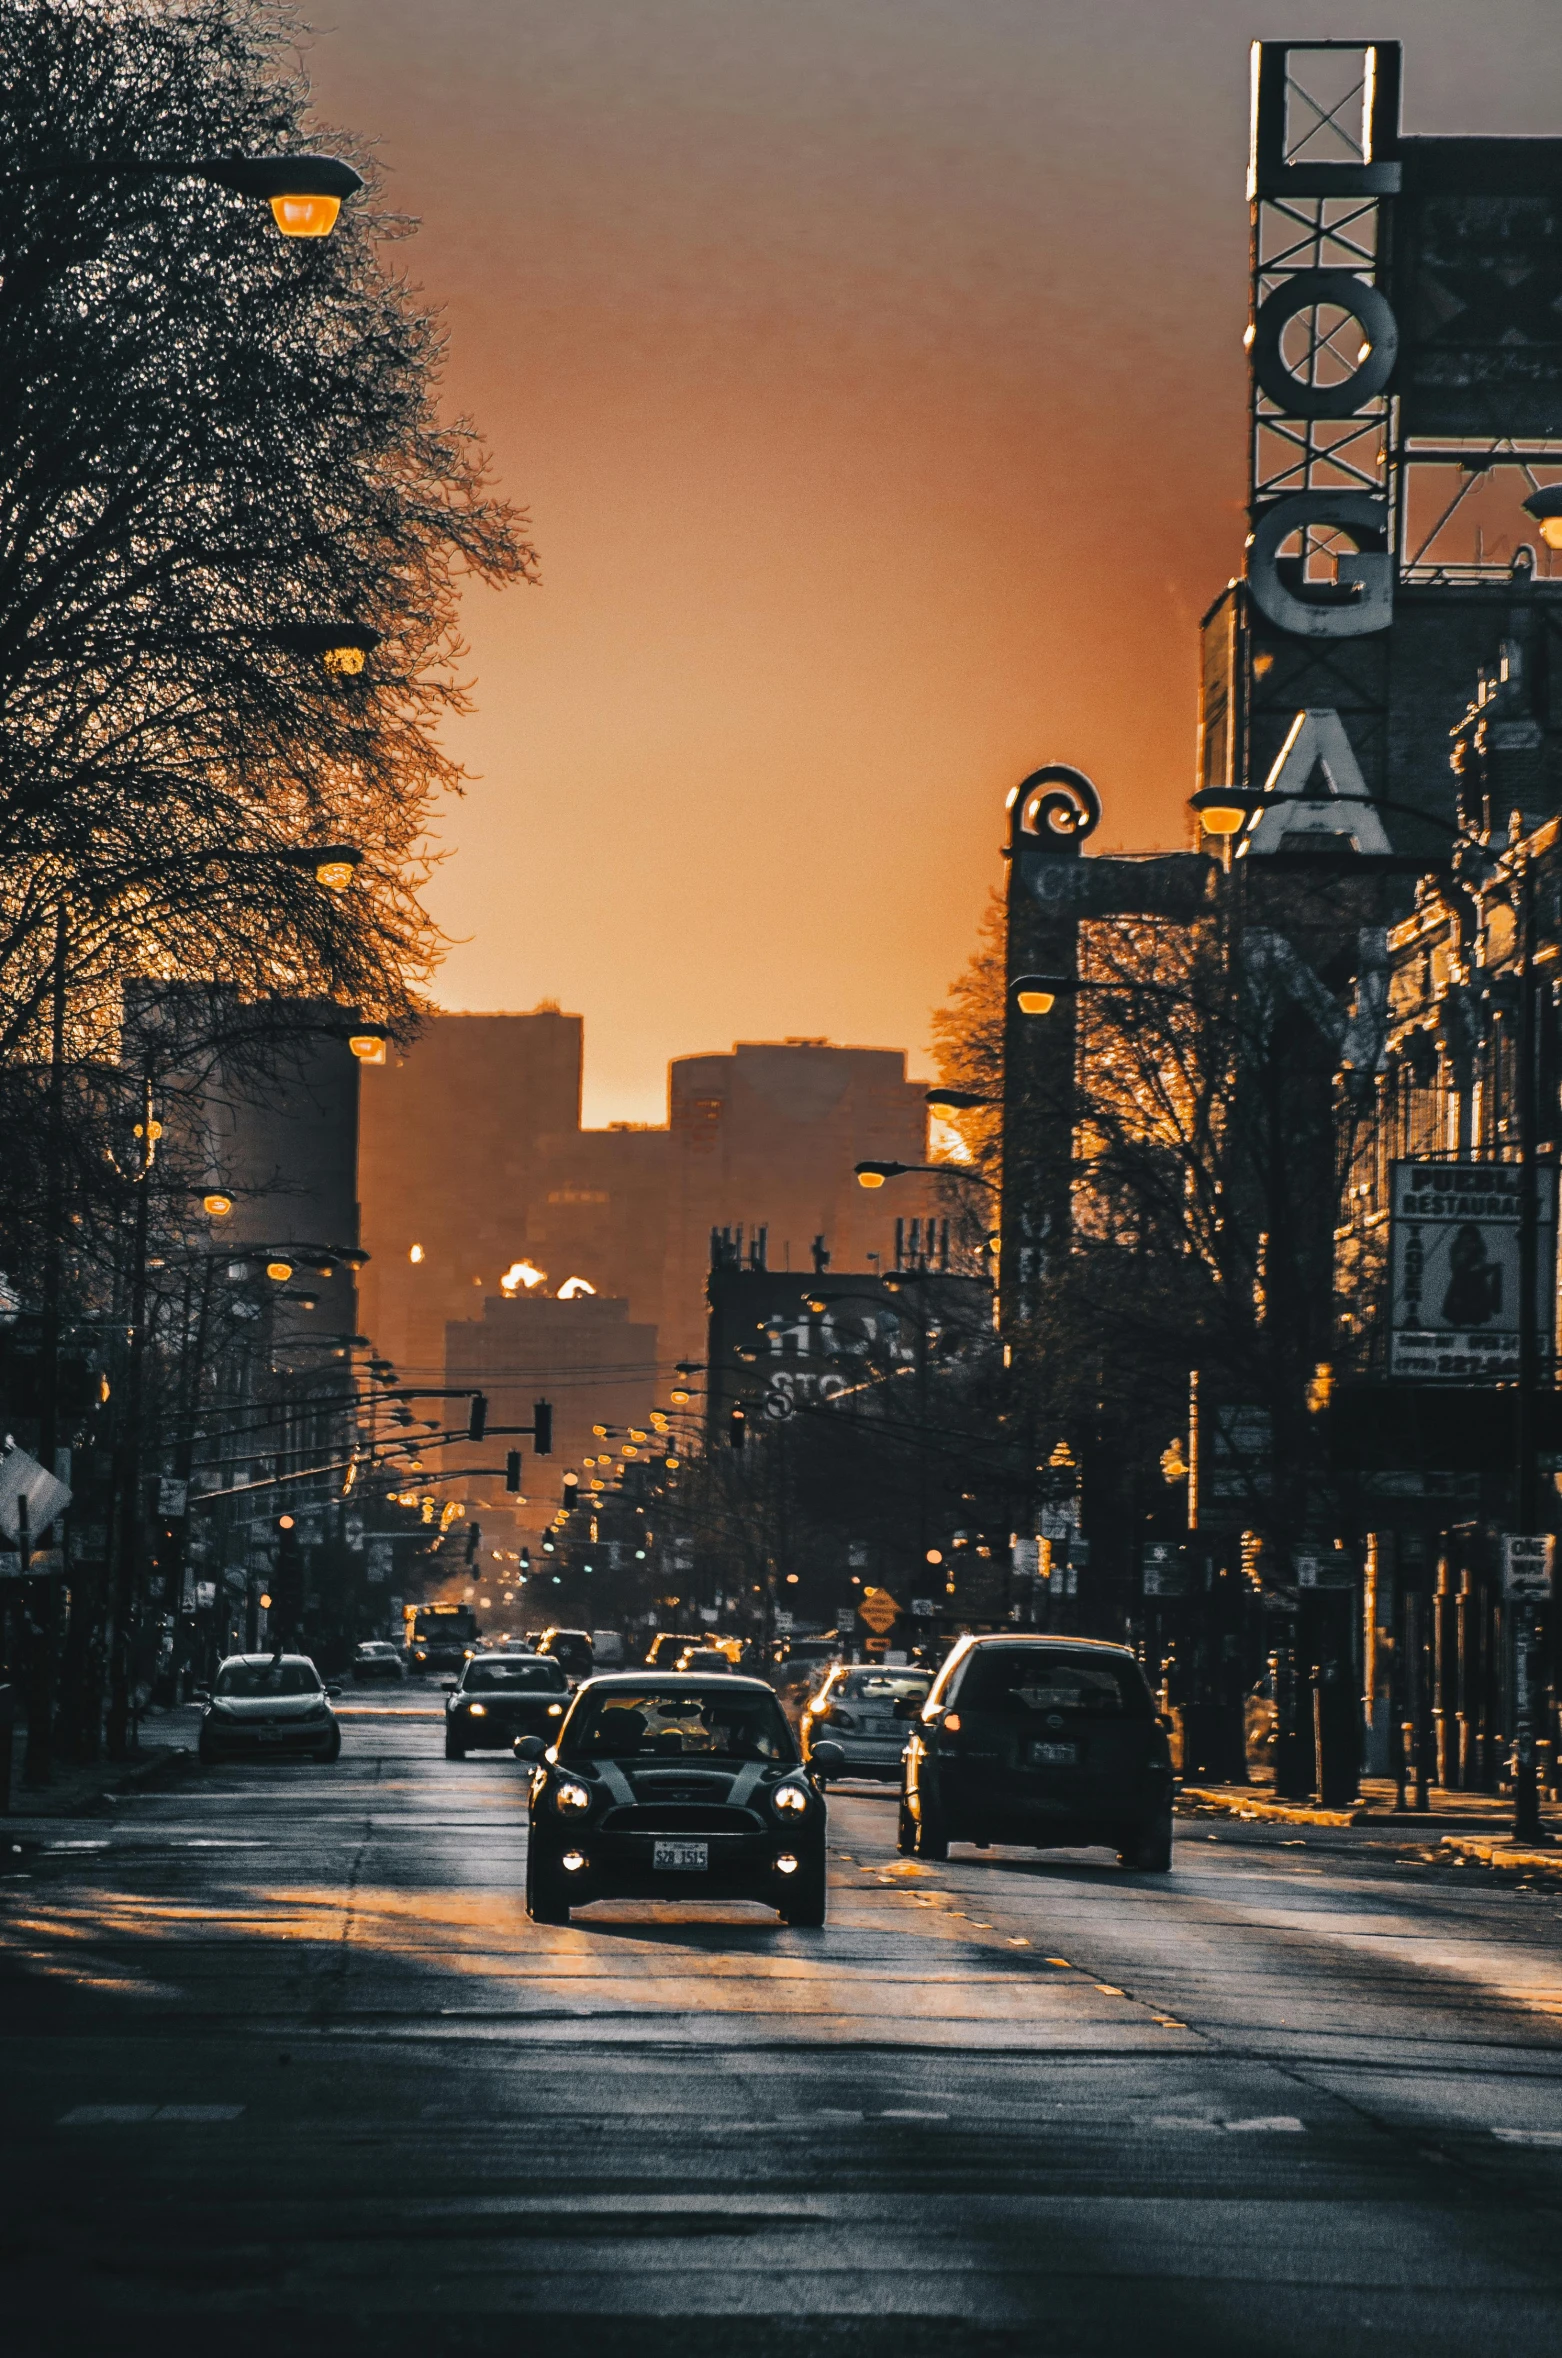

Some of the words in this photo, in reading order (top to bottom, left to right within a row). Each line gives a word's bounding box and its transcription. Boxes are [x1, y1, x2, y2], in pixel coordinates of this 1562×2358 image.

[1412, 1169, 1524, 1193] PUEBL
[1511, 1540, 1545, 1556] ONE
[1511, 1559, 1547, 1575] WAY
